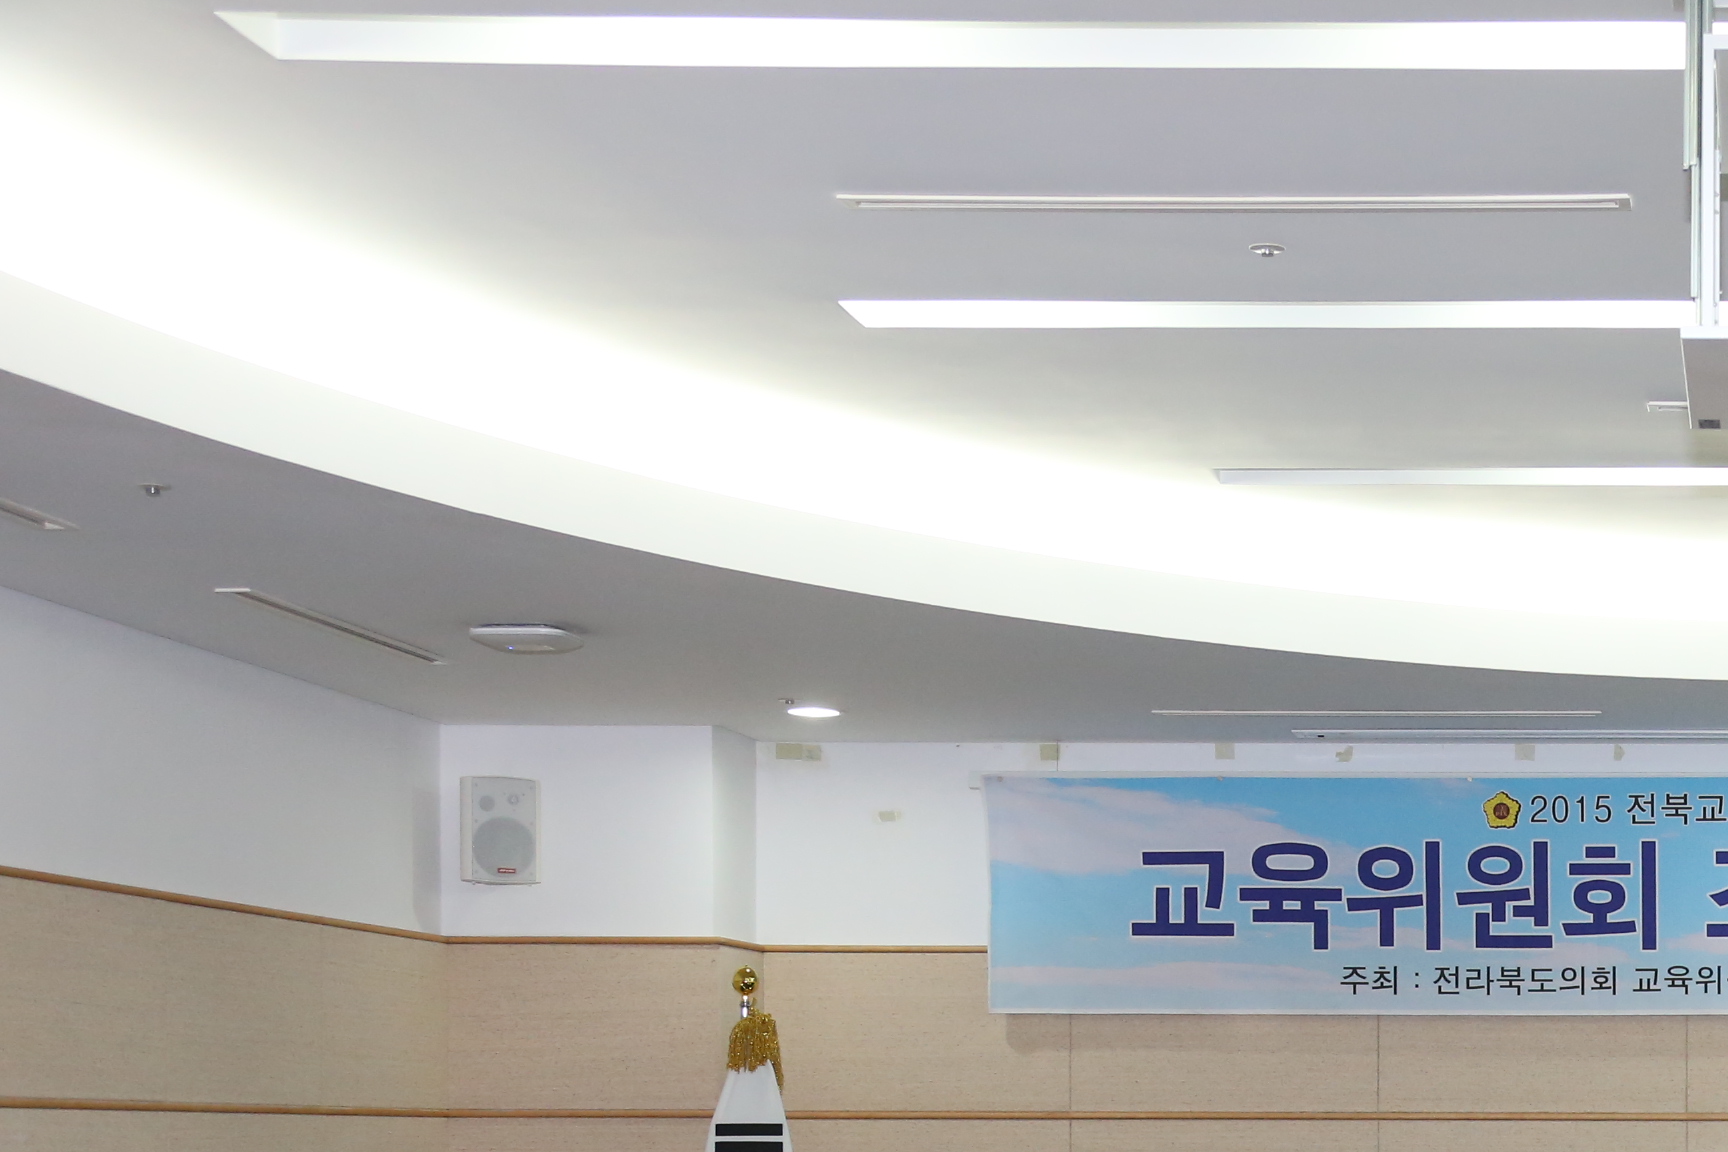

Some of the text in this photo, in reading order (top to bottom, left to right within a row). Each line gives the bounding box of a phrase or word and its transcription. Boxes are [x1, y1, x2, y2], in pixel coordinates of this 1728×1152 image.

[1530, 795, 1612, 823] 2015
[1131, 840, 1659, 952] 교육위원회
[1339, 964, 1398, 996] 주최
[1432, 965, 1617, 996] 전라북도의회
